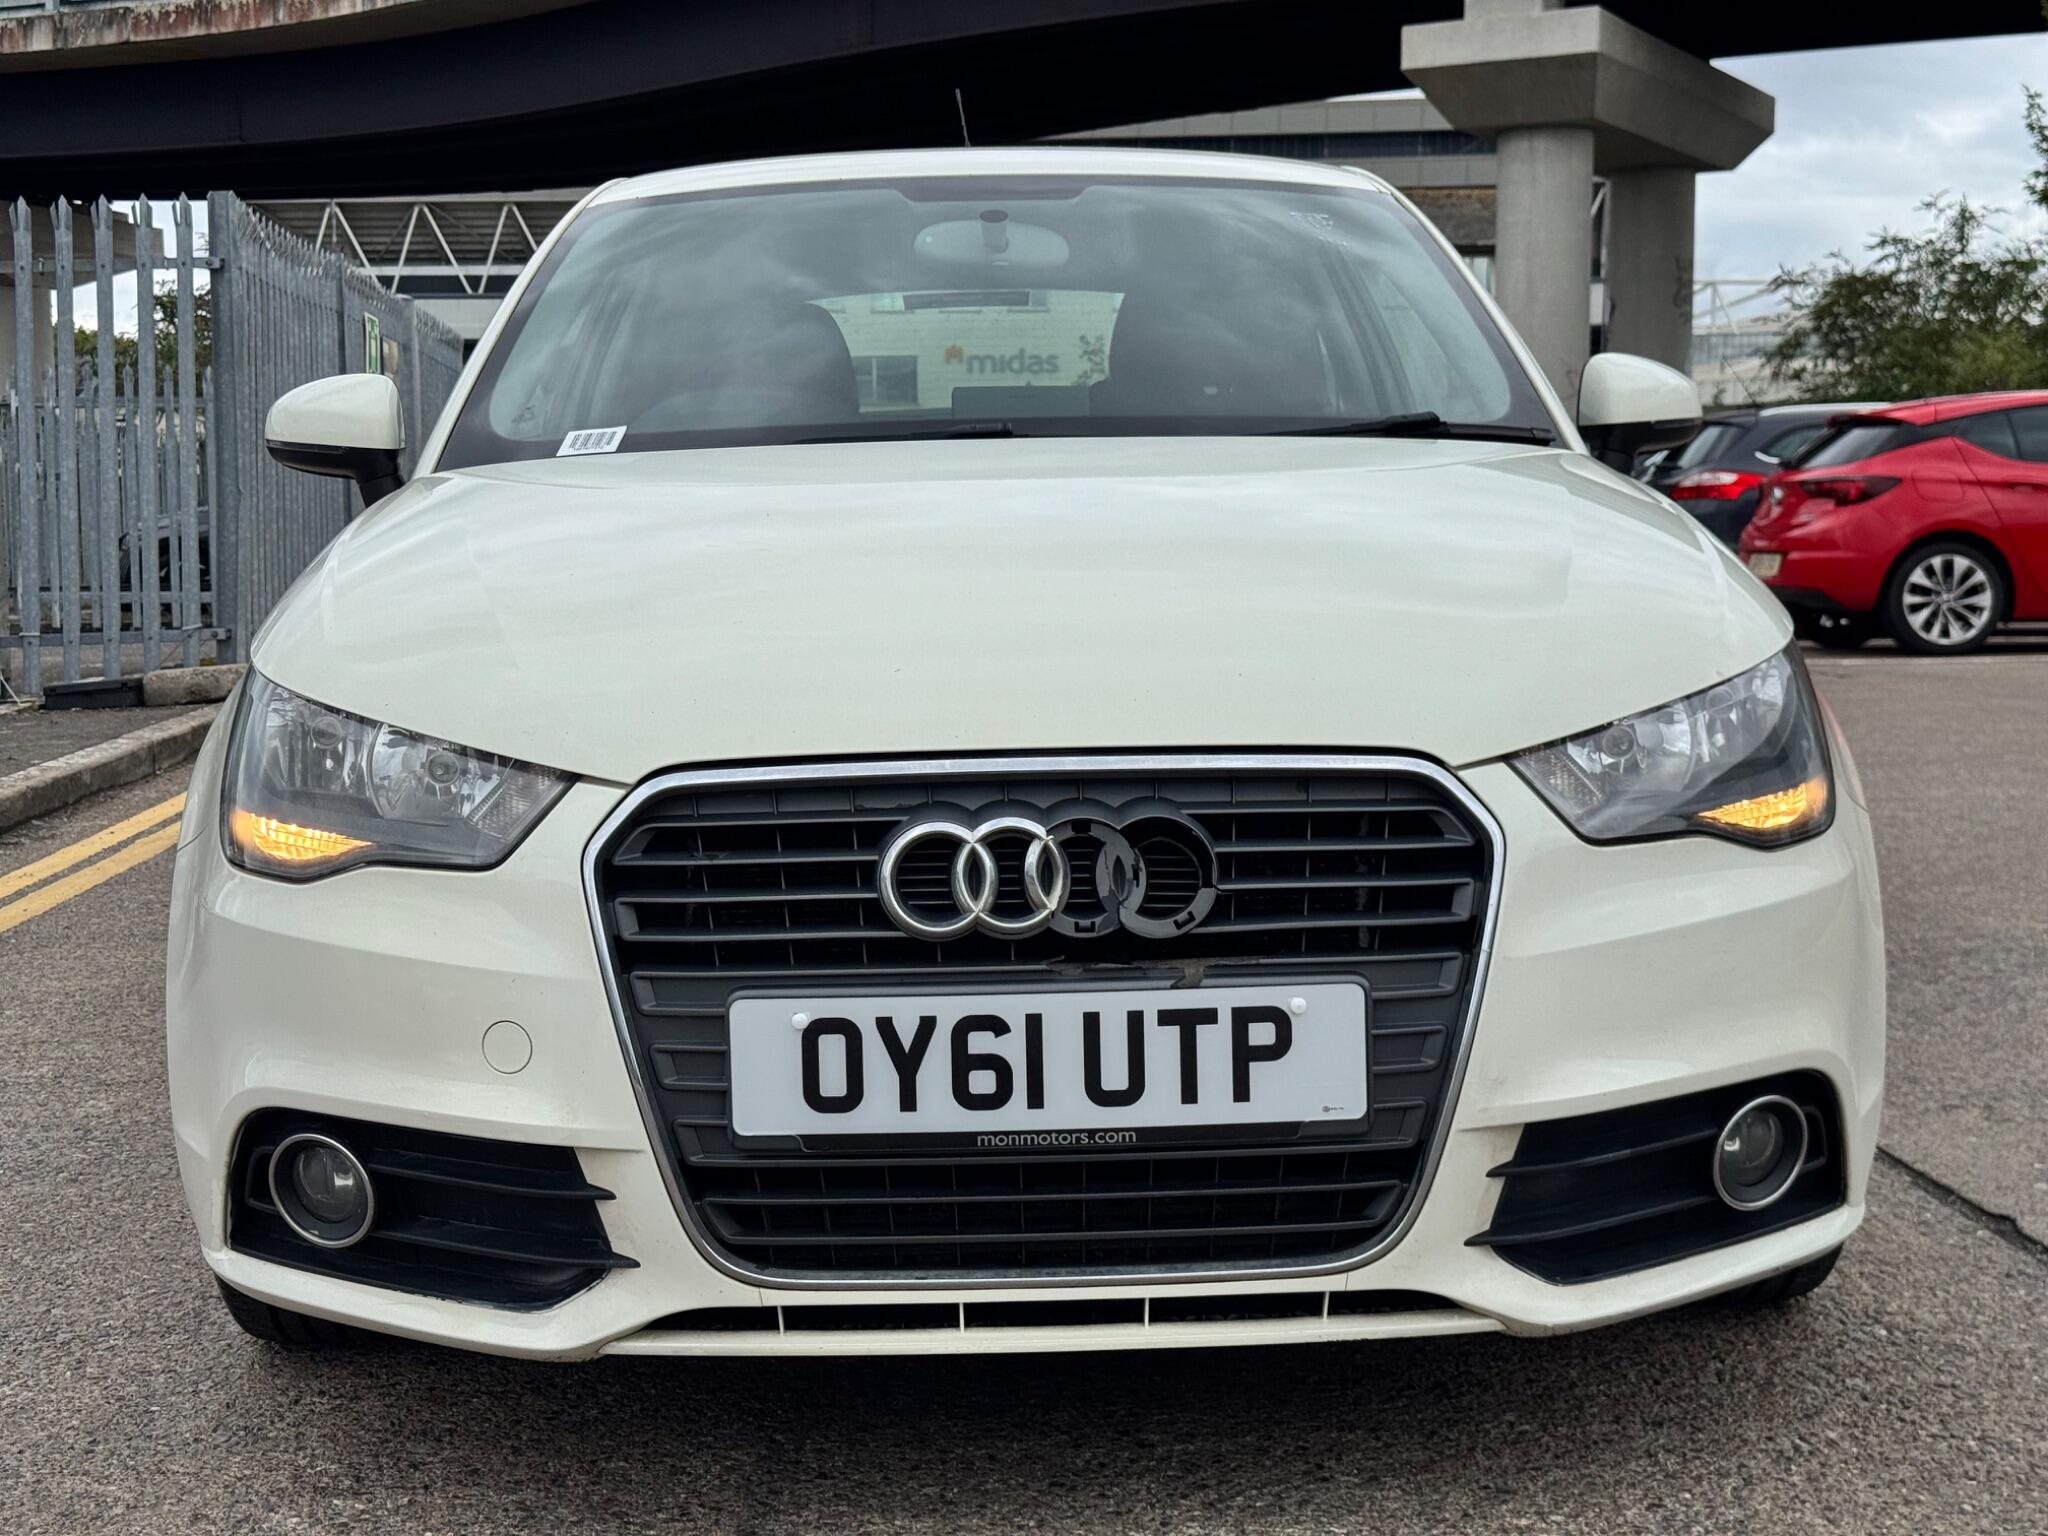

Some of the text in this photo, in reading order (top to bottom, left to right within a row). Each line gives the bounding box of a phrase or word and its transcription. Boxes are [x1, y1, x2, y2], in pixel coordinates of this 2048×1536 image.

[966, 348, 1060, 374] midas
[802, 1005, 1293, 1114] OY61 UTP
[977, 1131, 1137, 1147] monmotors.com
